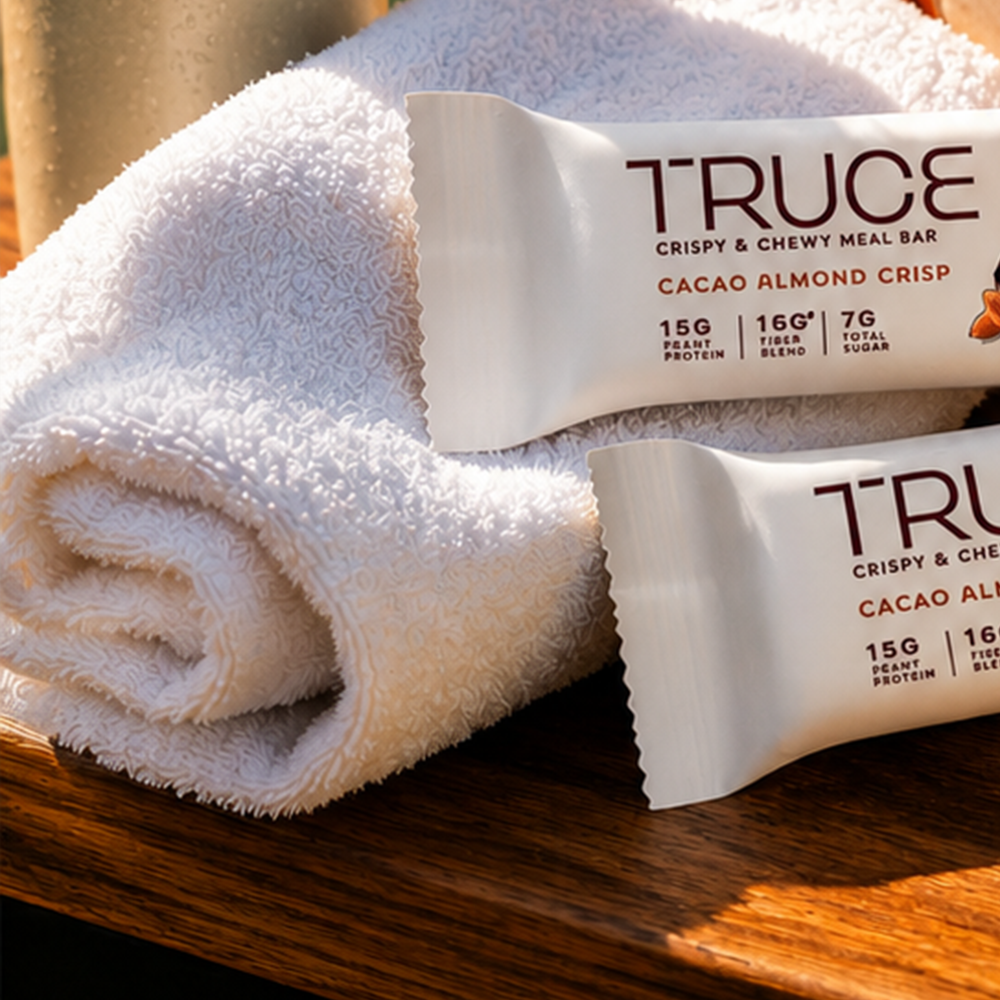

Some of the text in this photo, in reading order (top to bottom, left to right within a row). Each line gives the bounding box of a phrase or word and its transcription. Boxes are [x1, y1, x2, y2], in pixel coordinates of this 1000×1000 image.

[626, 146, 980, 234] TRUCE
[655, 229, 938, 256] CRISPY & CHEWY MEAL BAR
[657, 264, 951, 295] CACAO ALMOND CRISP
[659, 318, 712, 337] 15G
[841, 309, 876, 328] 7G
[843, 331, 886, 342] TOTAL
[843, 342, 890, 354] SUGAR
[852, 554, 926, 580] CRISPY
[934, 552, 949, 567] &
[858, 588, 950, 619] CACAO
[865, 637, 919, 662] 15G
